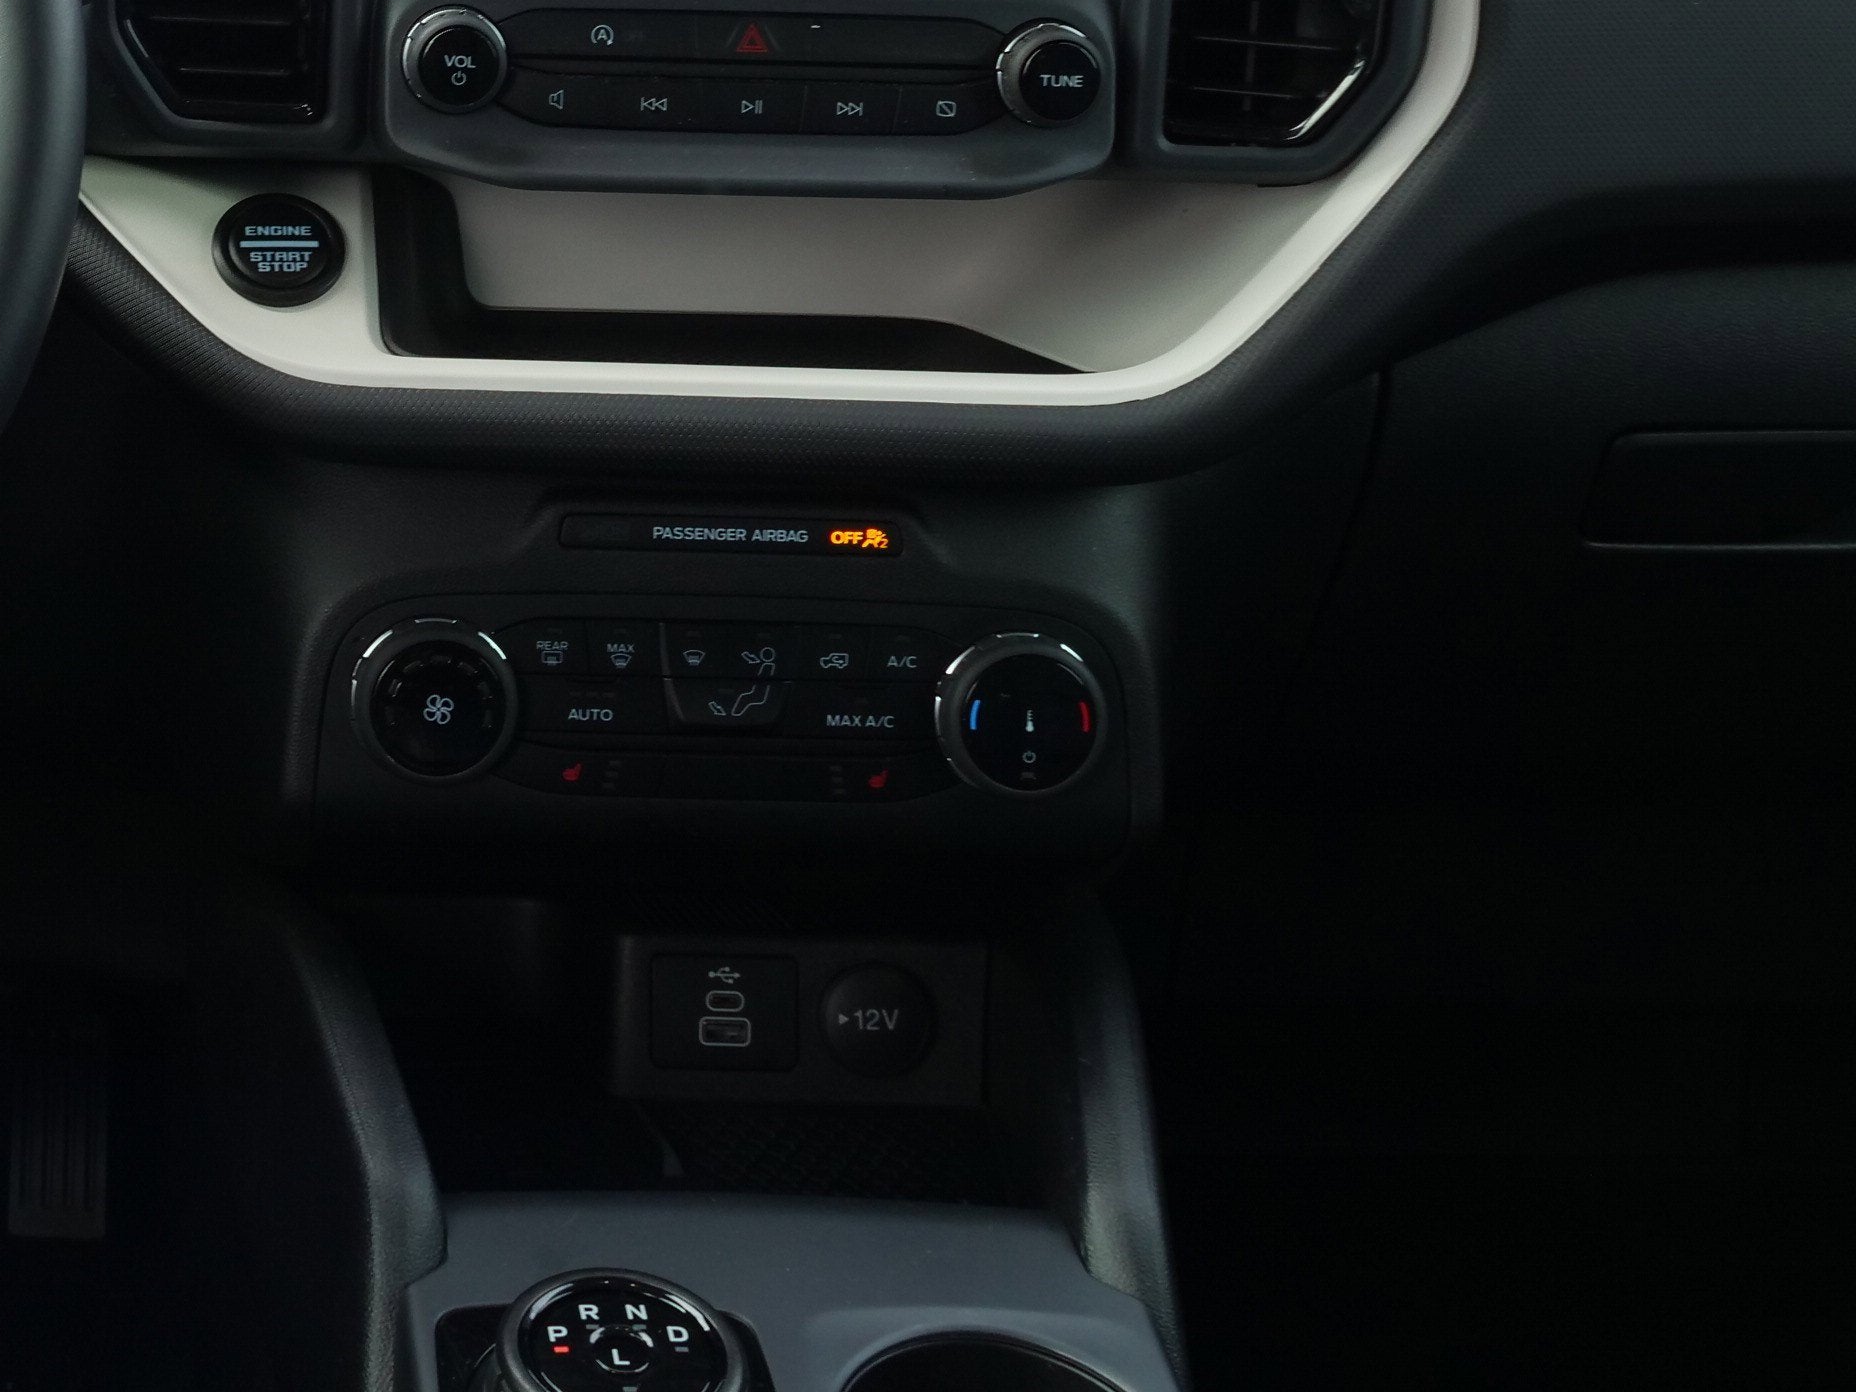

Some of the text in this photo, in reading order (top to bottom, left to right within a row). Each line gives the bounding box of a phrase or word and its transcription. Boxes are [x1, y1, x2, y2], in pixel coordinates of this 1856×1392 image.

[445, 55, 476, 69] VOL
[1039, 75, 1083, 88] TUNE
[244, 225, 312, 236] ENGINE
[250, 251, 313, 261] START
[257, 261, 308, 272] STOP
[653, 526, 863, 545] PASSENGER AIRBAG OFF
[536, 640, 569, 651] REAR
[606, 643, 635, 654] MAX
[887, 655, 917, 669] A/C
[568, 709, 613, 722] AUTO
[826, 714, 895, 729] MAX A/C
[853, 1009, 899, 1031] 12V
[578, 1304, 648, 1320] R N
[547, 1326, 689, 1342] P D
[611, 1348, 631, 1366] L
